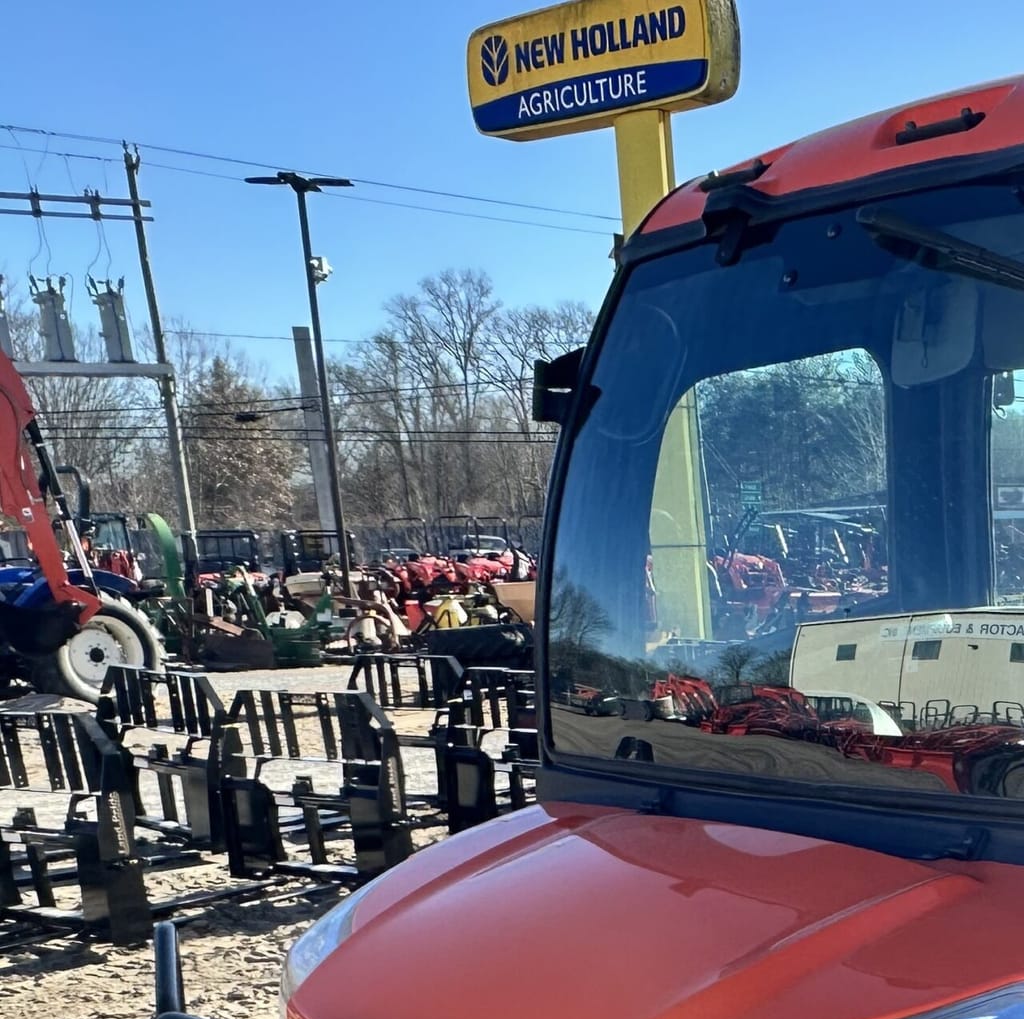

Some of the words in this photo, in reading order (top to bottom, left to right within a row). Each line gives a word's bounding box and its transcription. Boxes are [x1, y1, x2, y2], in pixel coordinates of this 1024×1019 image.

[515, 32, 565, 74] NEW
[571, 6, 686, 61] HOLLAND
[518, 70, 647, 118] AGRICULTURE
